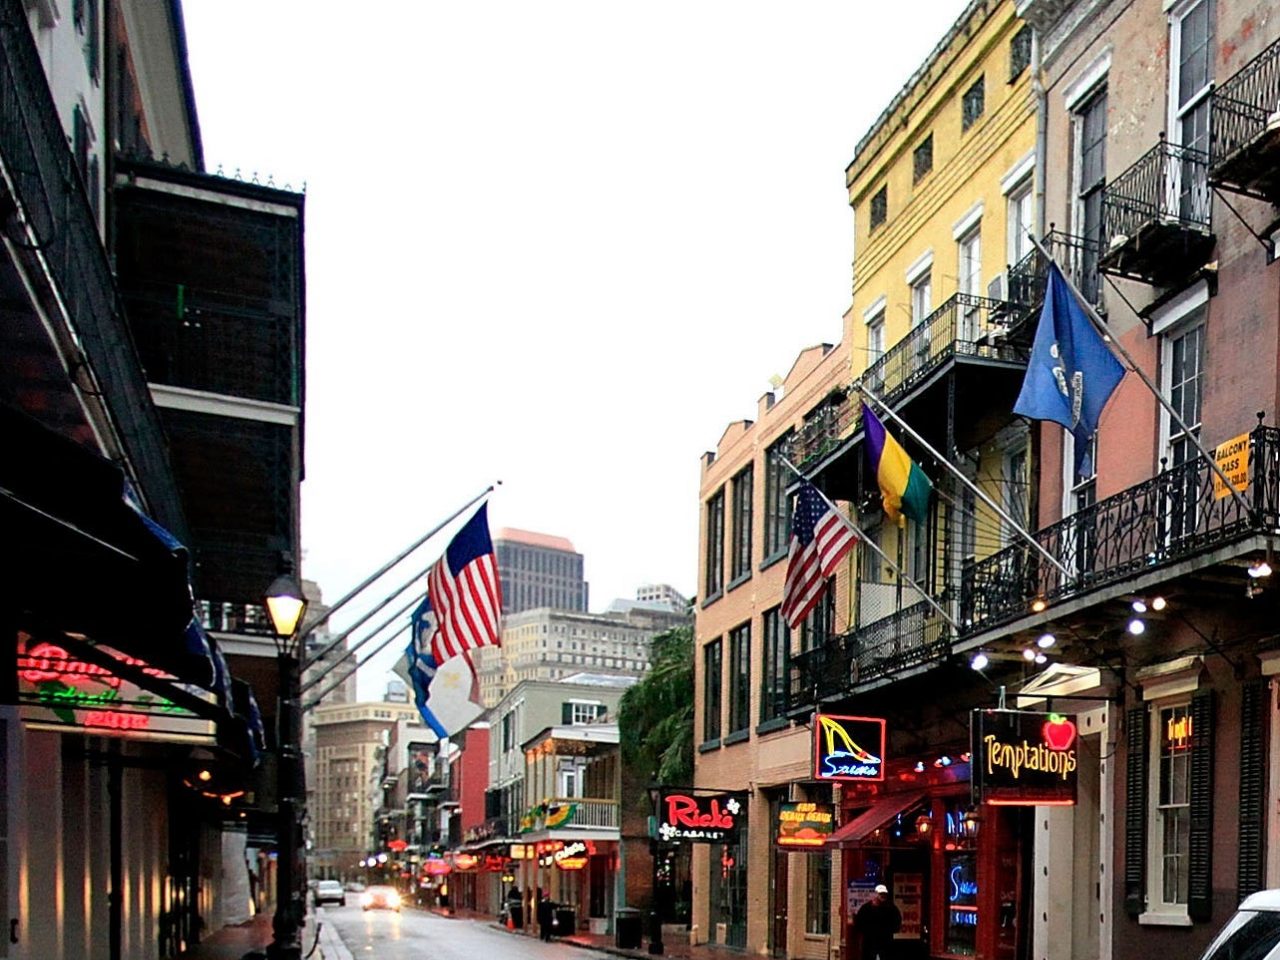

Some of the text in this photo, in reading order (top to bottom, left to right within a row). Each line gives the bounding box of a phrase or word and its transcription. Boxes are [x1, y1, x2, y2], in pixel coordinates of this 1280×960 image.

[1222, 458, 1240, 473] PASS
[984, 735, 1077, 780] Temptations
[664, 794, 735, 829] Rick's
